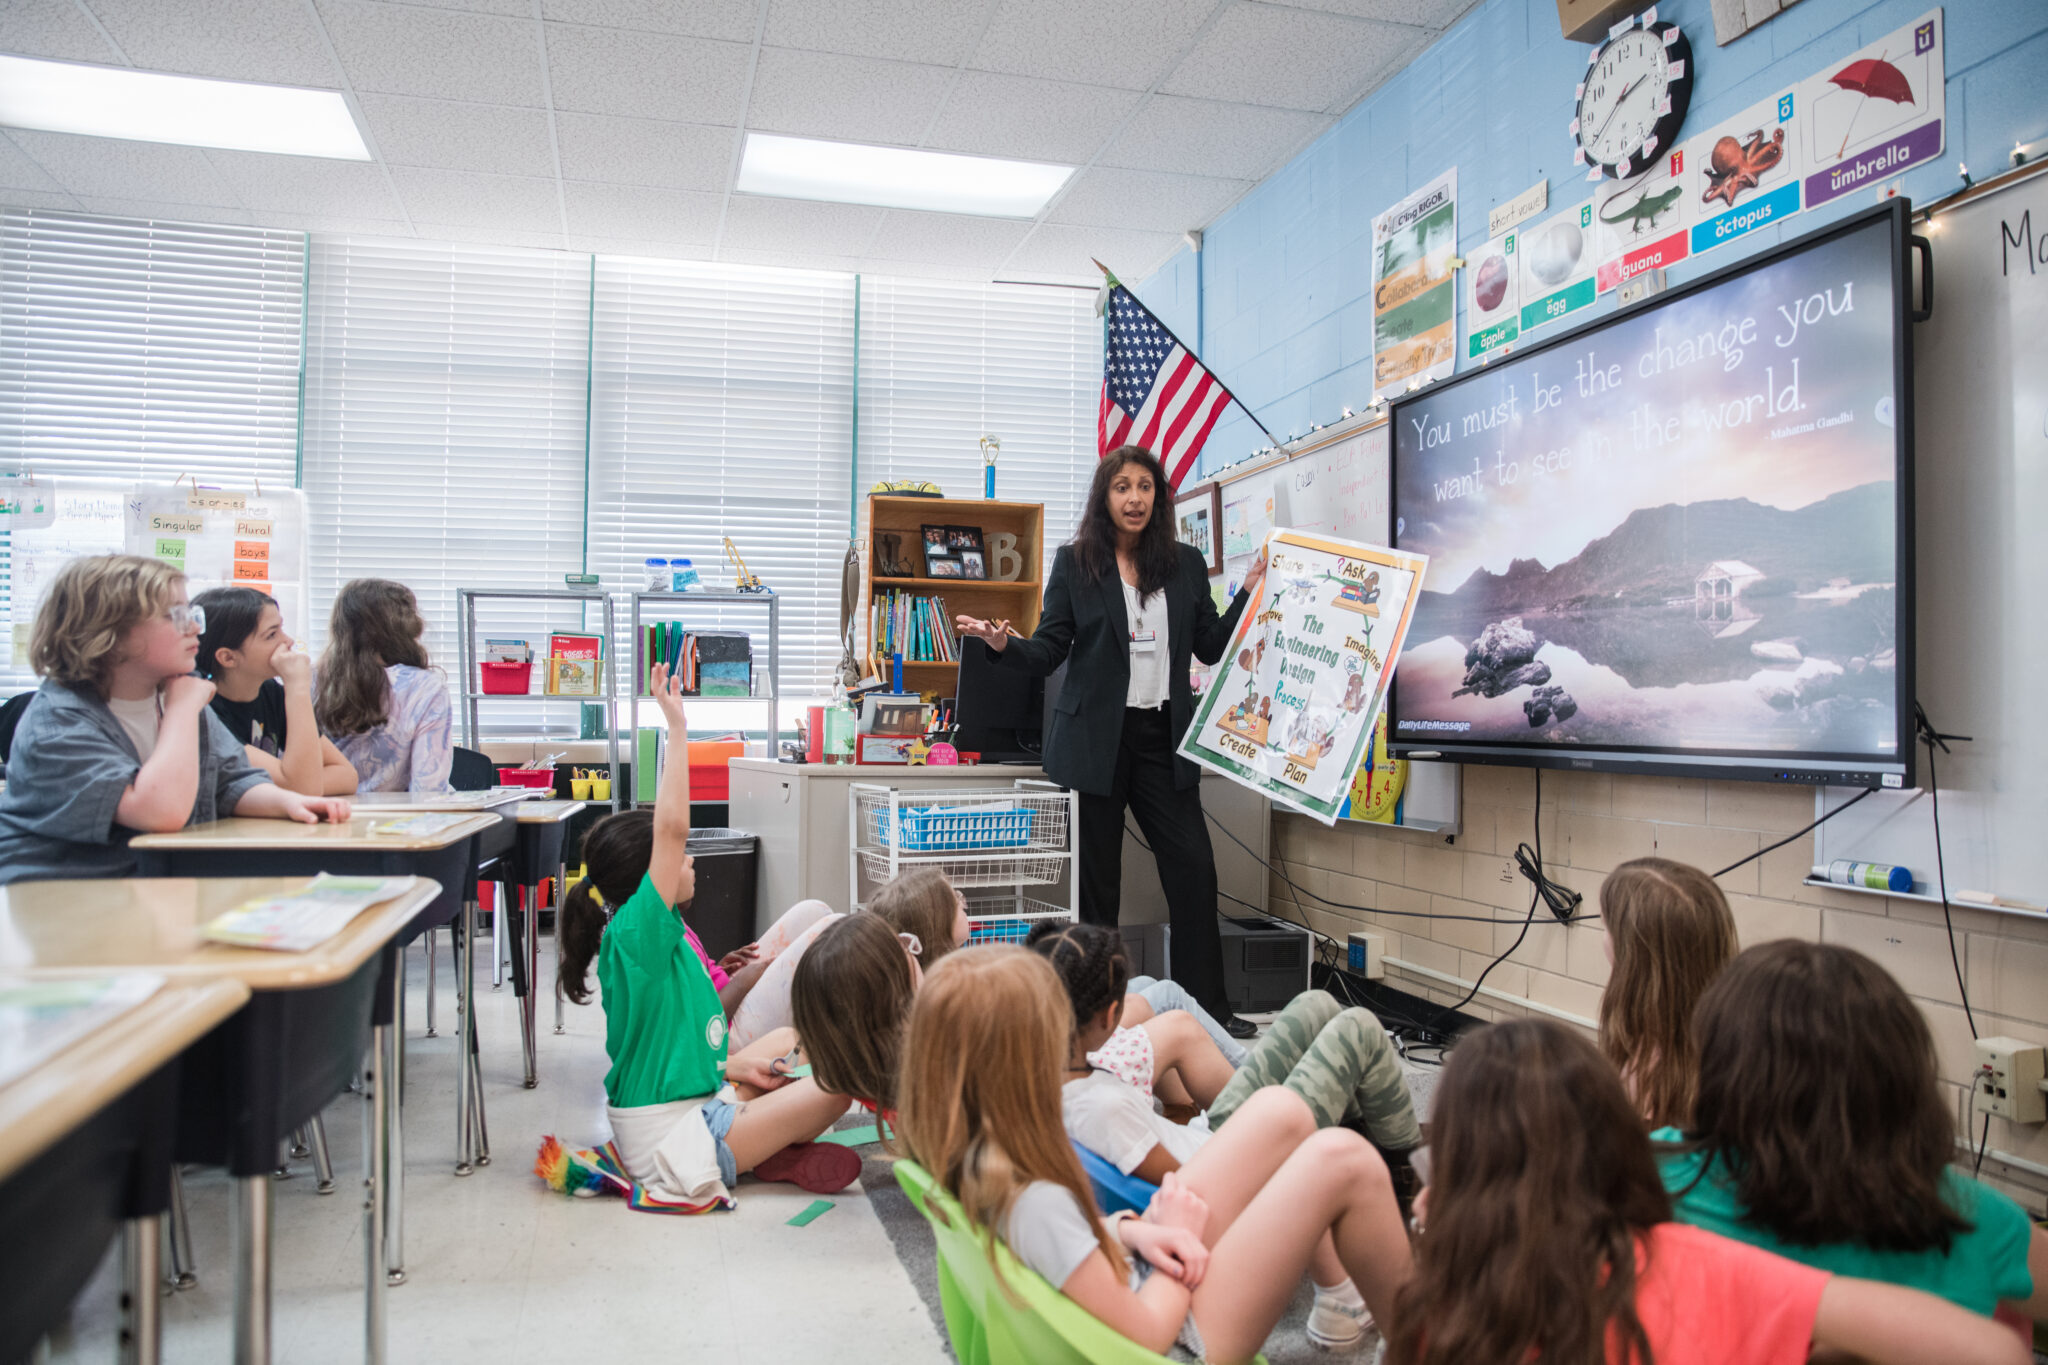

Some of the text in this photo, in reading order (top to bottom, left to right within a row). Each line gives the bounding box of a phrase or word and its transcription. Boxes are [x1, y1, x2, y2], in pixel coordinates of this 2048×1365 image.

[1666, 29, 1678, 40] 10
[1618, 44, 1630, 63] 12
[1640, 43, 1643, 57] 1
[1603, 61, 1613, 80] 11
[1593, 85, 1605, 103] 10
[1587, 111, 1594, 126] 9
[1418, 191, 1443, 214] RIGOR
[1490, 187, 1547, 231] short vowels
[1375, 318, 1414, 341] Ceate
[1411, 281, 1854, 451] You must be the change you
[1433, 456, 1484, 503] want
[1496, 449, 1519, 486] to
[1532, 446, 1572, 478] see
[1589, 428, 1613, 462] in
[1628, 402, 1680, 450] the
[1700, 357, 1807, 434] world.
[1770, 419, 1815, 442] Mahatma
[1816, 409, 1855, 430] Gandhi
[153, 516, 202, 534] Singular
[237, 523, 270, 536] Plural
[161, 543, 181, 558] boy
[240, 545, 266, 560] boys
[239, 565, 264, 578] toys
[1272, 554, 1304, 571] Share
[1343, 561, 1366, 579] Ask
[1303, 614, 1324, 635] The
[1344, 635, 1381, 672] Imagine
[1280, 656, 1316, 685] Dsign
[1274, 679, 1306, 710] Process
[1398, 720, 1471, 732] DailyLifeMessage
[1219, 732, 1257, 760] Create
[1282, 762, 1308, 785] Plan
[1383, 779, 1390, 794] 4
[1357, 789, 1363, 804] 7
[1375, 791, 1381, 806] 5
